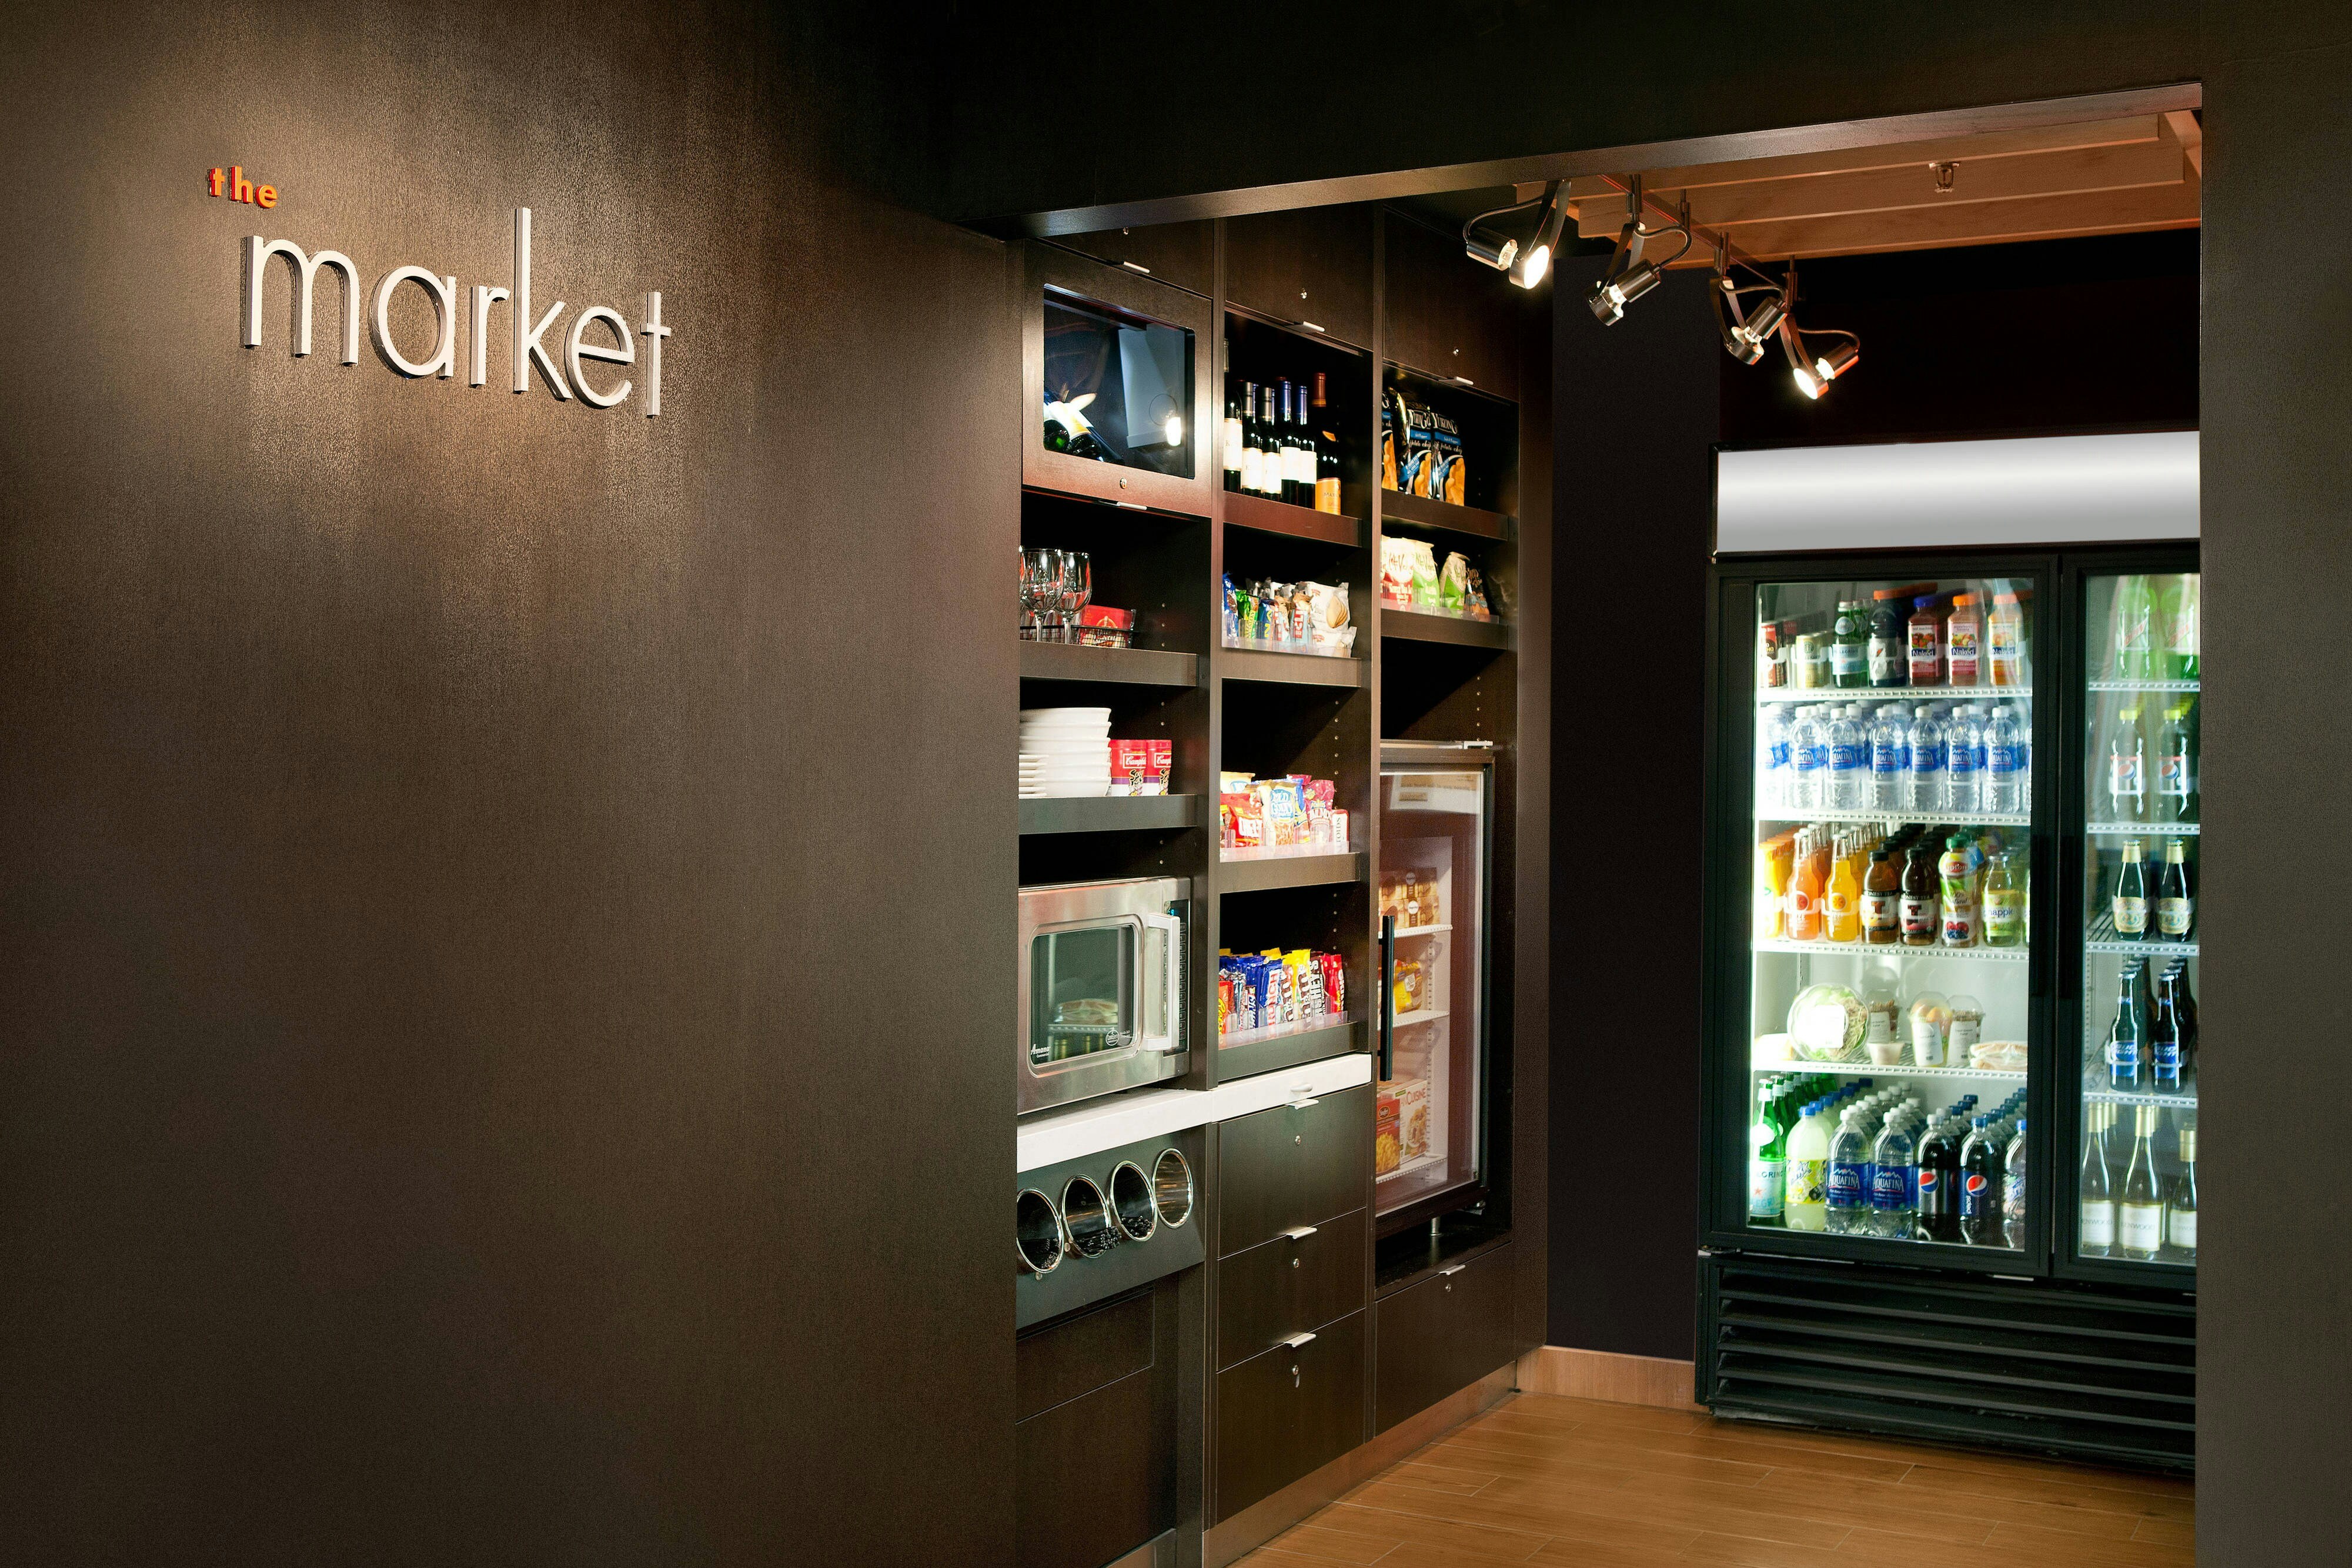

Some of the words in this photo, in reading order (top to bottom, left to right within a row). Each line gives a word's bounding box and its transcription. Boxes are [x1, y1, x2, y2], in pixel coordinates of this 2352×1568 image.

[209, 166, 278, 209] the
[243, 206, 671, 418] market
[1912, 648, 1934, 657] Naked
[1952, 647, 1975, 656] Naked
[1876, 752, 1897, 764] QUAFINA
[1952, 753, 1973, 764] QUAFINA
[1030, 1044, 1051, 1055] Amana
[1828, 1175, 1860, 1189] AQUAFINA
[1872, 1177, 1905, 1193] AQUAFINA
